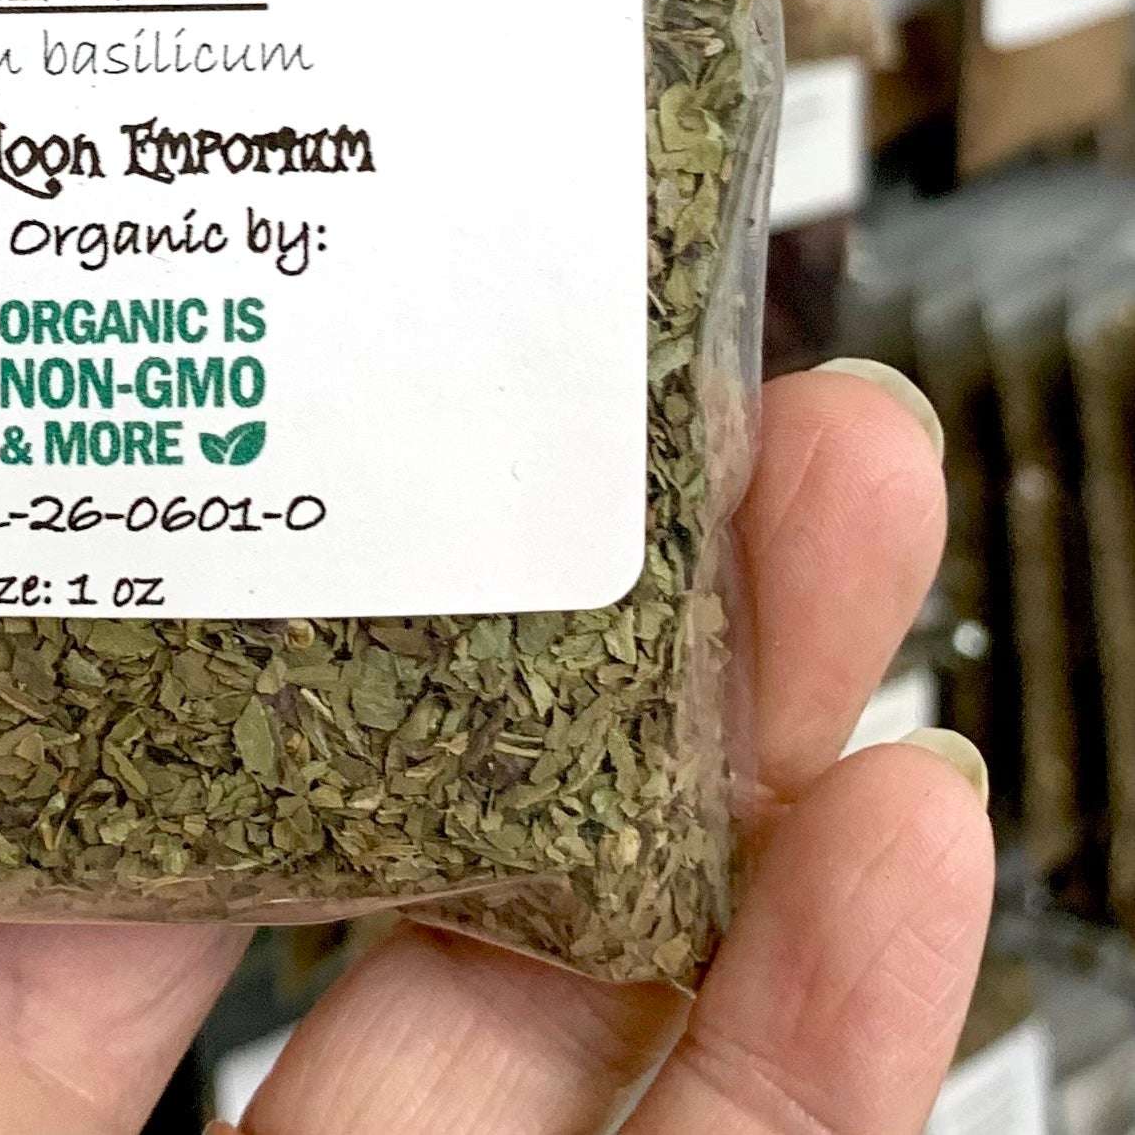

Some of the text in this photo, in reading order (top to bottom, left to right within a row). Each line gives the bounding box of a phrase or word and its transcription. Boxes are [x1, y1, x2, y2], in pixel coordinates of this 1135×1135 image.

[43, 27, 314, 77] basilicum
[9, 208, 229, 272] Organic
[246, 206, 327, 277] by:
[223, 296, 267, 344] IS
[0, 355, 266, 410] NON-GMO
[44, 420, 184, 467] MORE
[67, 573, 98, 606] 1
[112, 576, 166, 608] oz
